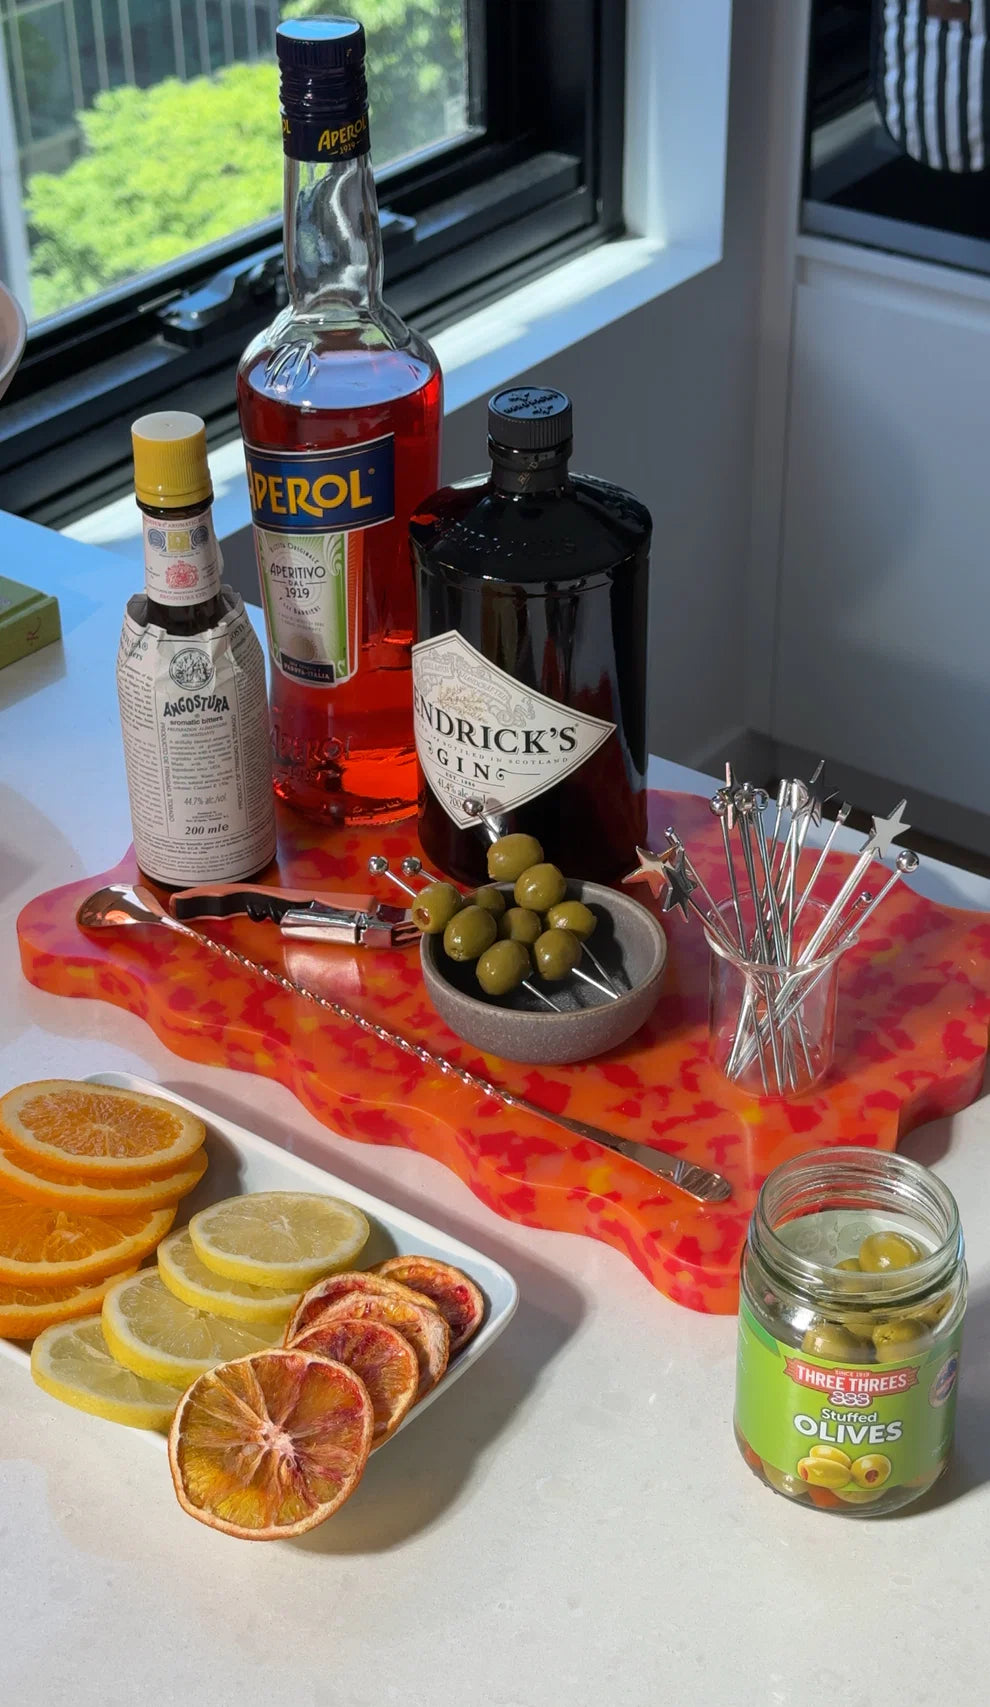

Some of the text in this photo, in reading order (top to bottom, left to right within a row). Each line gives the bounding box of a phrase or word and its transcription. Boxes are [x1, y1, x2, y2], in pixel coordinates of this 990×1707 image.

[318, 116, 368, 152] APEROL
[270, 563, 326, 579] APERITIVO
[285, 587, 310, 599] 1919
[163, 694, 230, 717] ANGOSTURA
[201, 715, 223, 724] bitters
[443, 740, 485, 760] BOTTLED
[490, 757, 503, 765] IN
[508, 757, 569, 766] SCOTLAND
[437, 748, 491, 781] GIN
[445, 772, 459, 782] EST.
[437, 777, 457, 794] 41.4%
[184, 796, 204, 806] 44.7%
[448, 795, 462, 808] 700
[185, 825, 205, 835] 200
[797, 1365, 907, 1392] THREE THREES
[821, 1408, 877, 1424] Stuffed
[793, 1414, 903, 1444] OLIVES
